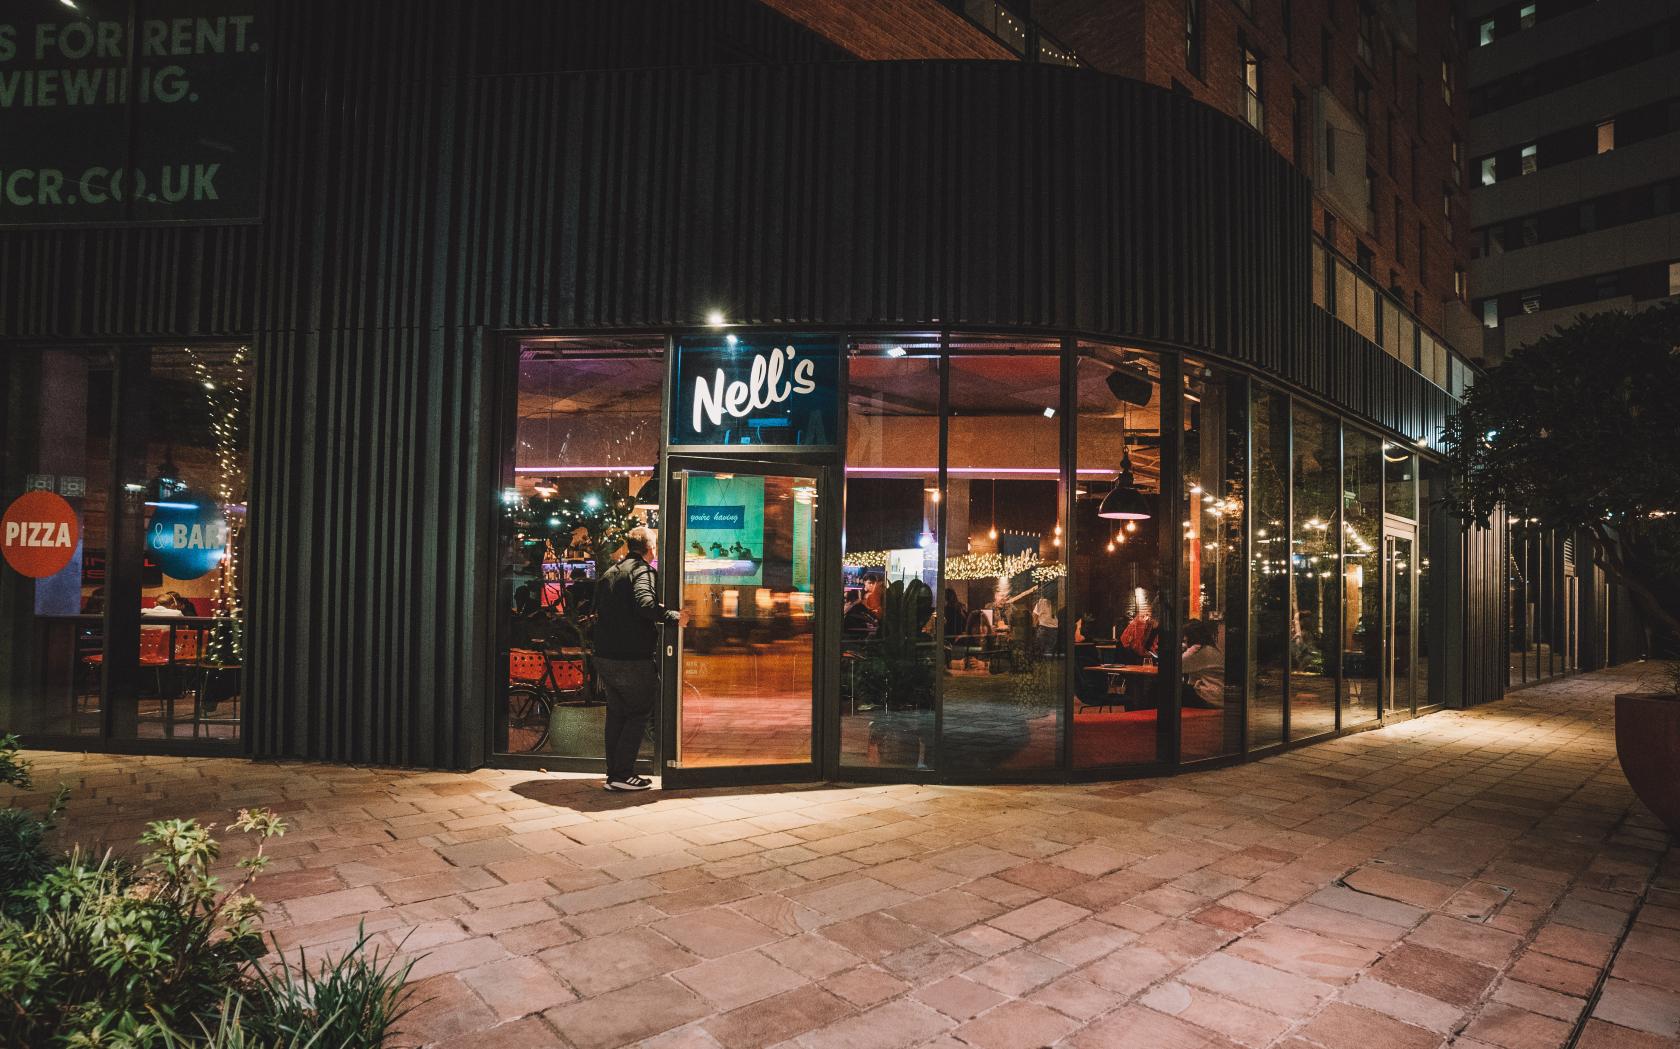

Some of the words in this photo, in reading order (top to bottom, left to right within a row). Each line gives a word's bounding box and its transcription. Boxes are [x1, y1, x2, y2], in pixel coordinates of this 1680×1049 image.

[36, 21, 123, 60] FOR
[143, 15, 260, 56] RENT.
[0, 163, 221, 206] CR.CO.UK
[692, 345, 816, 433] Nell's
[5, 521, 72, 548] PIZZA
[713, 511, 739, 524] having
[153, 522, 168, 550] &
[173, 523, 225, 549] BAR
